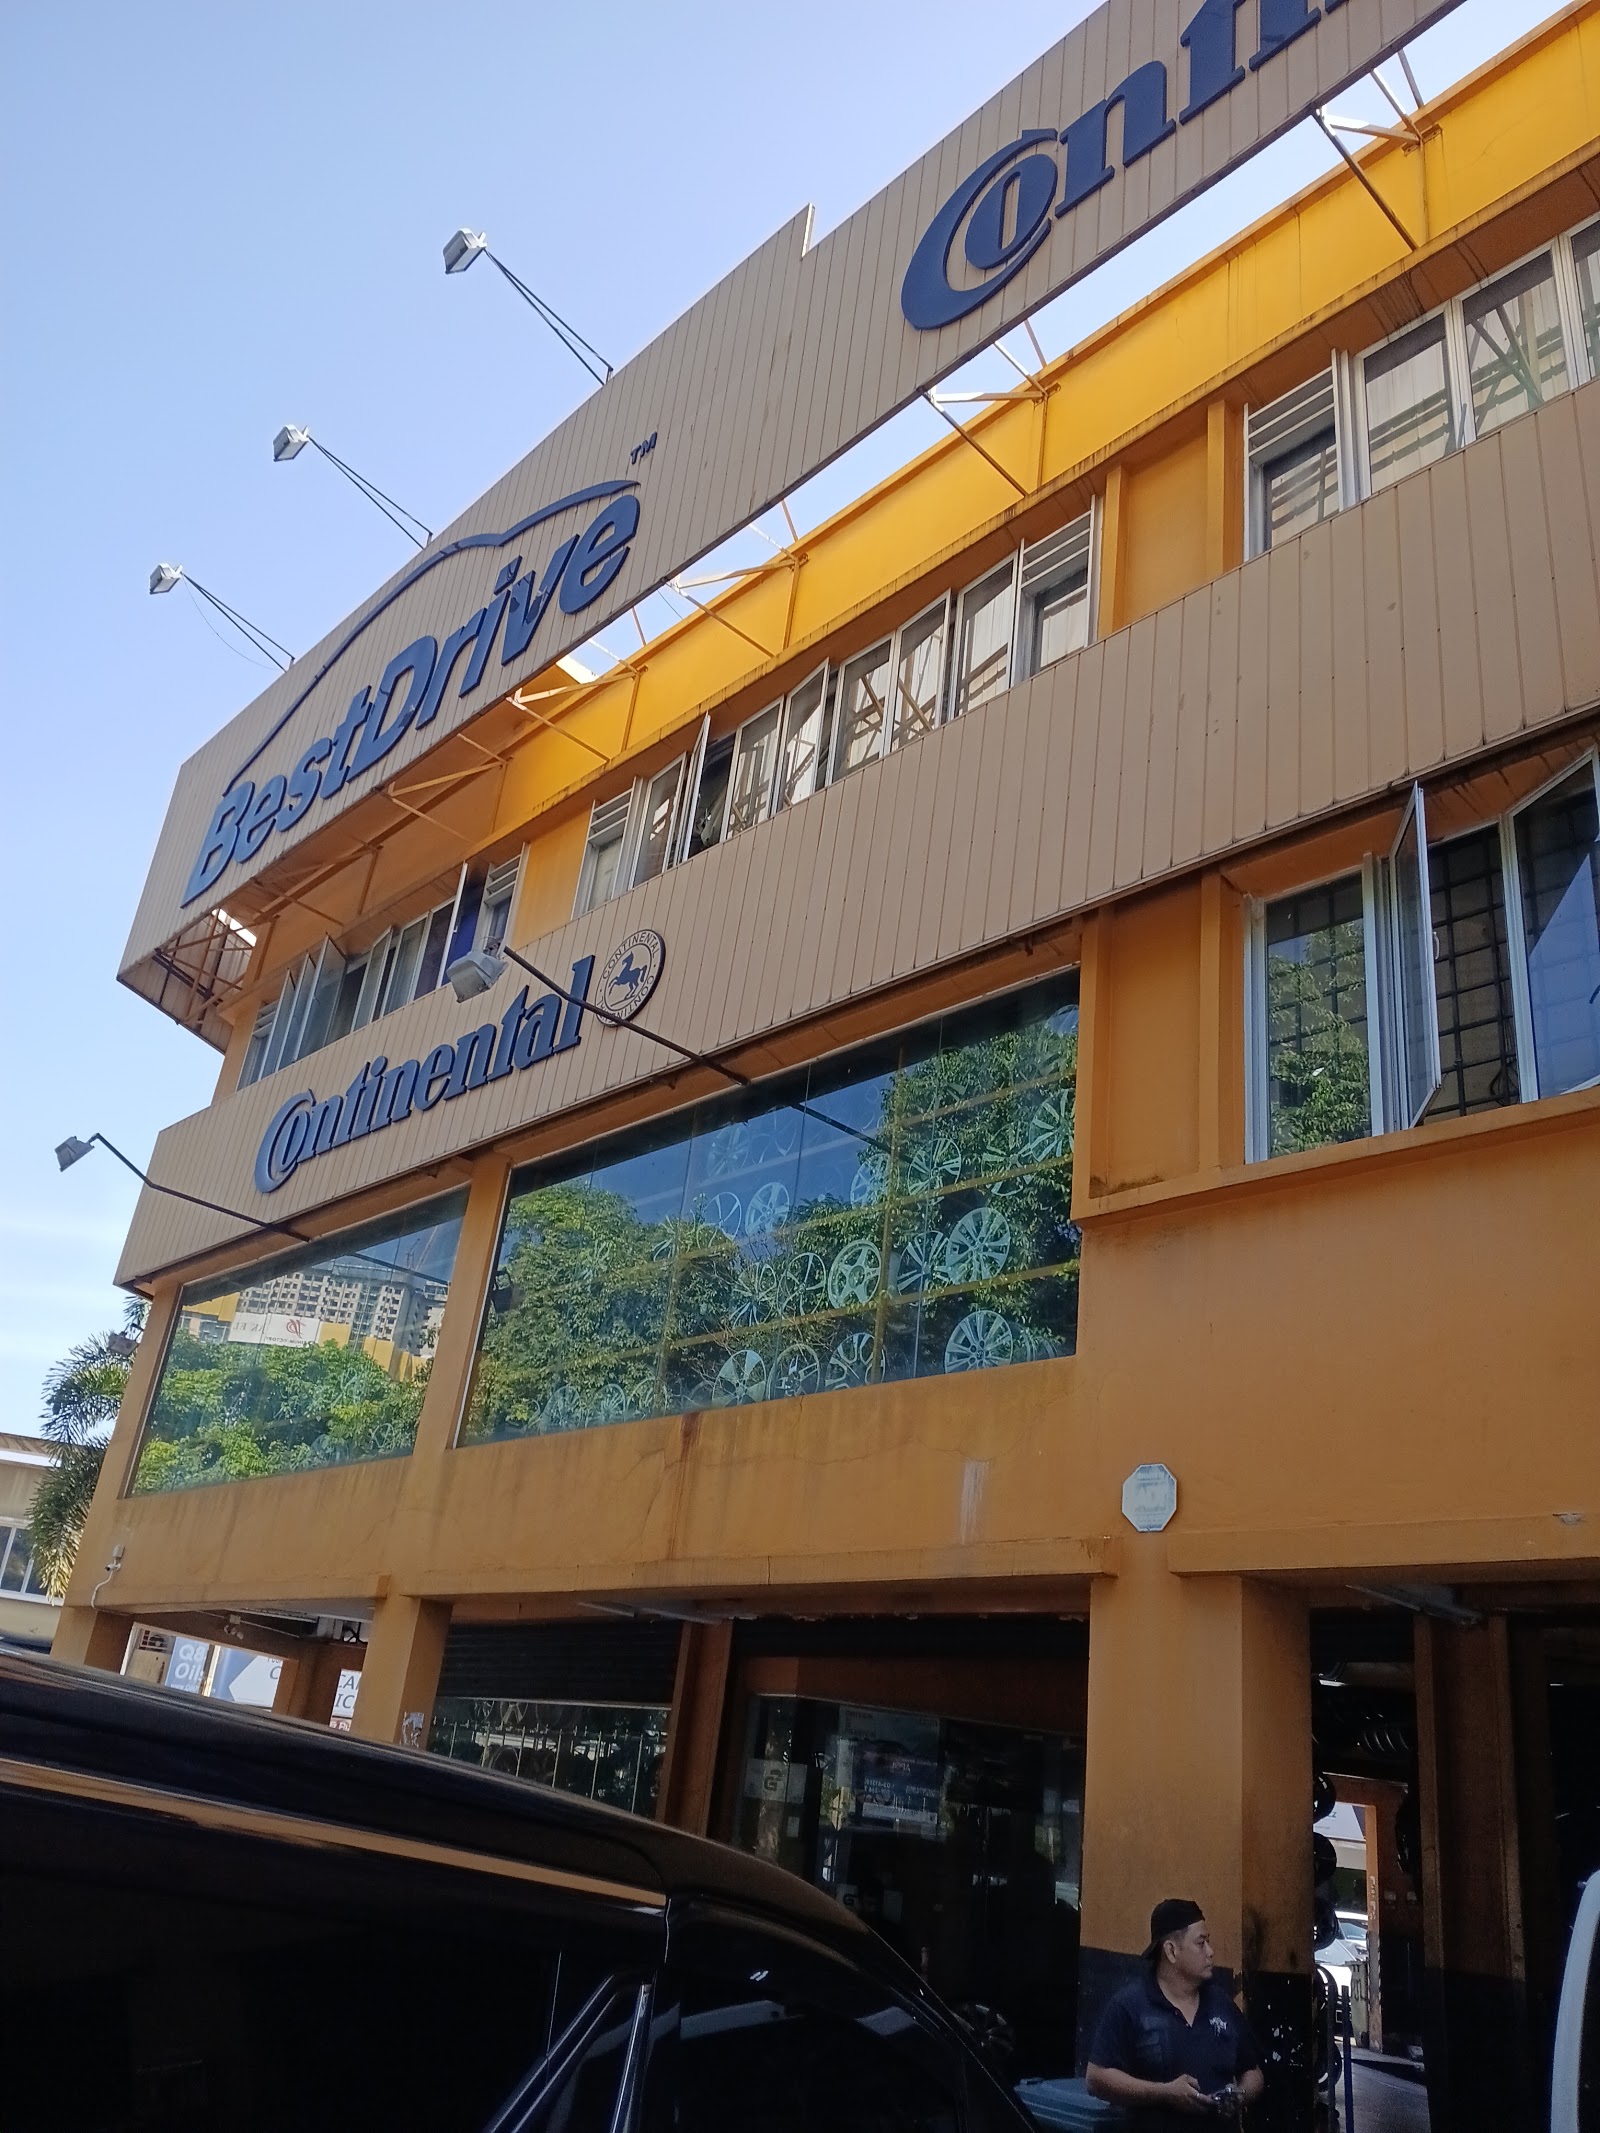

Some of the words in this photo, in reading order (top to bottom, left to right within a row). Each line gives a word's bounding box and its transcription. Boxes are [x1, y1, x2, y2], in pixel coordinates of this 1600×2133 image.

[180, 494, 641, 909] BestDrive
[630, 431, 658, 466] TM
[254, 954, 596, 1194] Continental
[602, 931, 661, 980] CONTINENTAL
